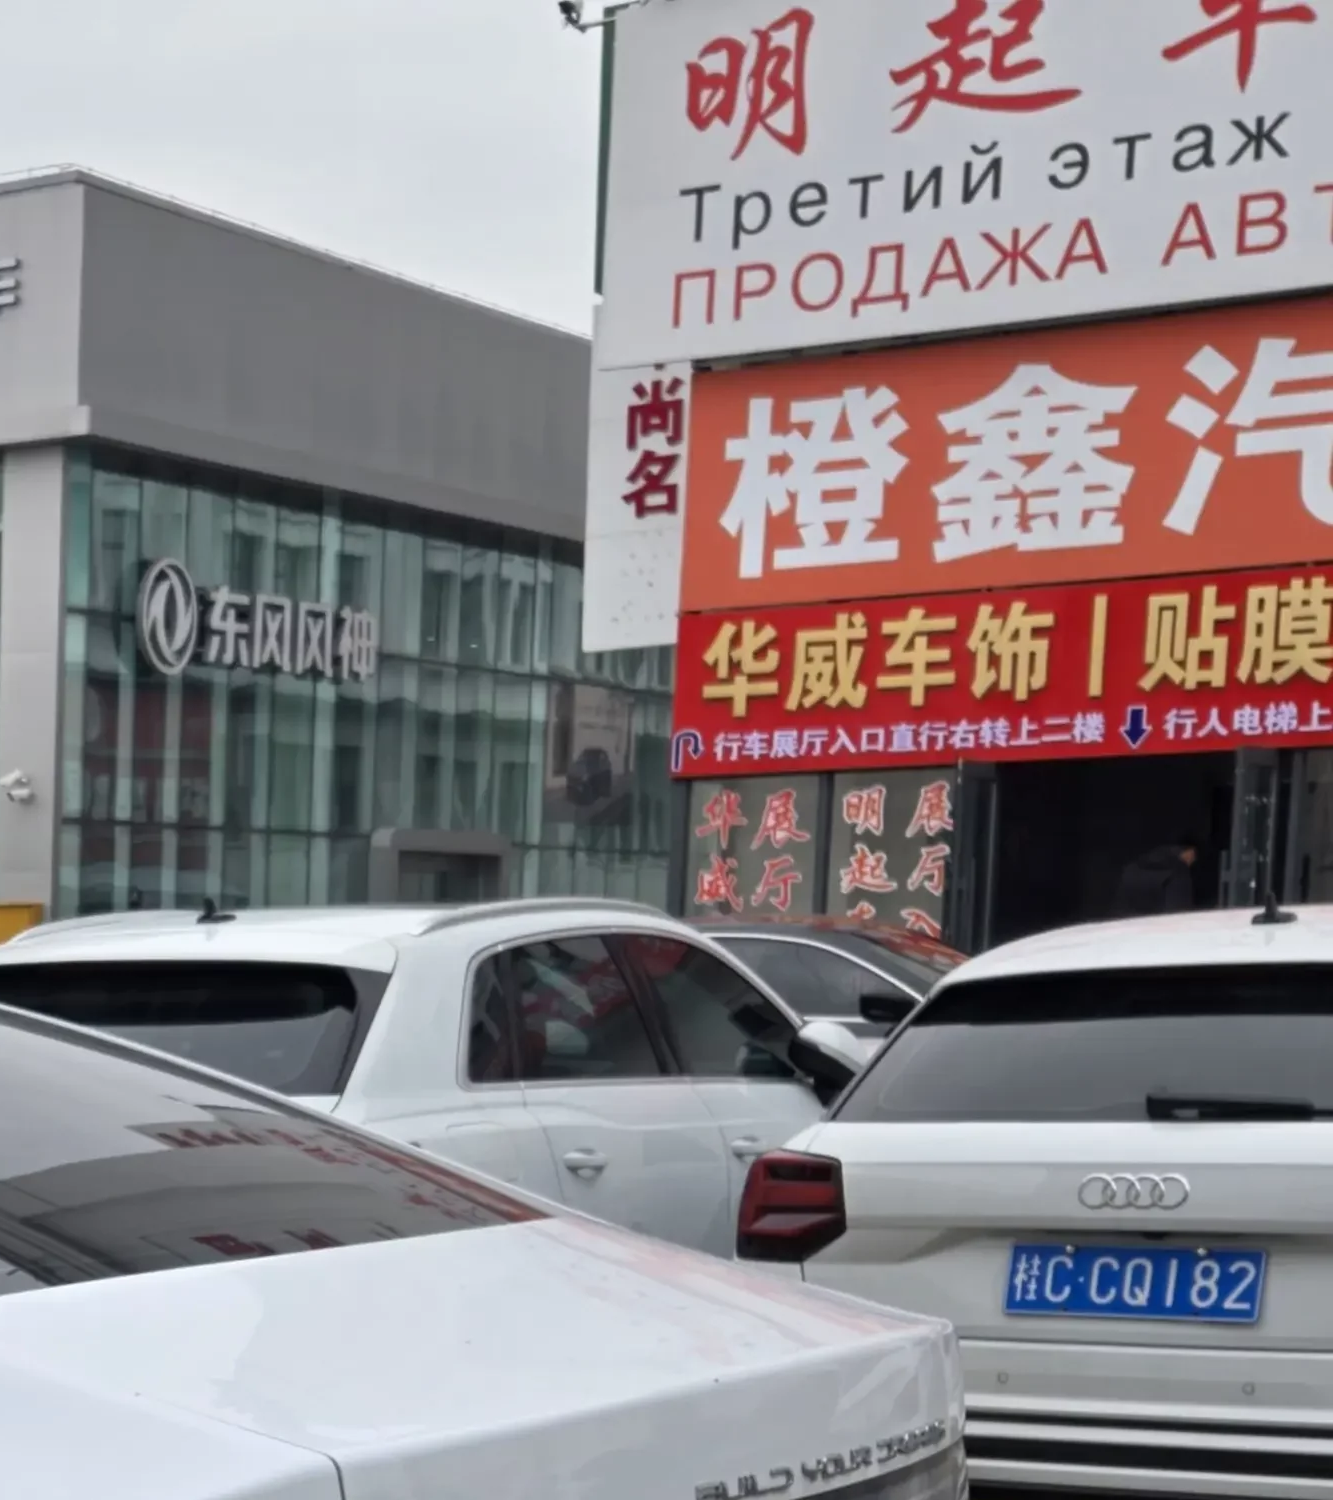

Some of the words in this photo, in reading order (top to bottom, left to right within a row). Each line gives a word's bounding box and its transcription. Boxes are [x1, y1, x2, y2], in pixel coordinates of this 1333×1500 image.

[679, 140, 1003, 249] Третий
[1047, 111, 1291, 191] этаж
[670, 216, 1109, 329] ПРОДАЖА
[621, 375, 686, 519] 尚名
[719, 337, 1333, 579] 橙鑫汽
[204, 584, 378, 682] 东风风神
[701, 599, 1056, 719] 华威车饰
[1136, 576, 1333, 691] 贴膜
[713, 710, 1105, 762] 行车展厅入口直行右转上二楼
[1162, 700, 1333, 740] 行人电梯上
